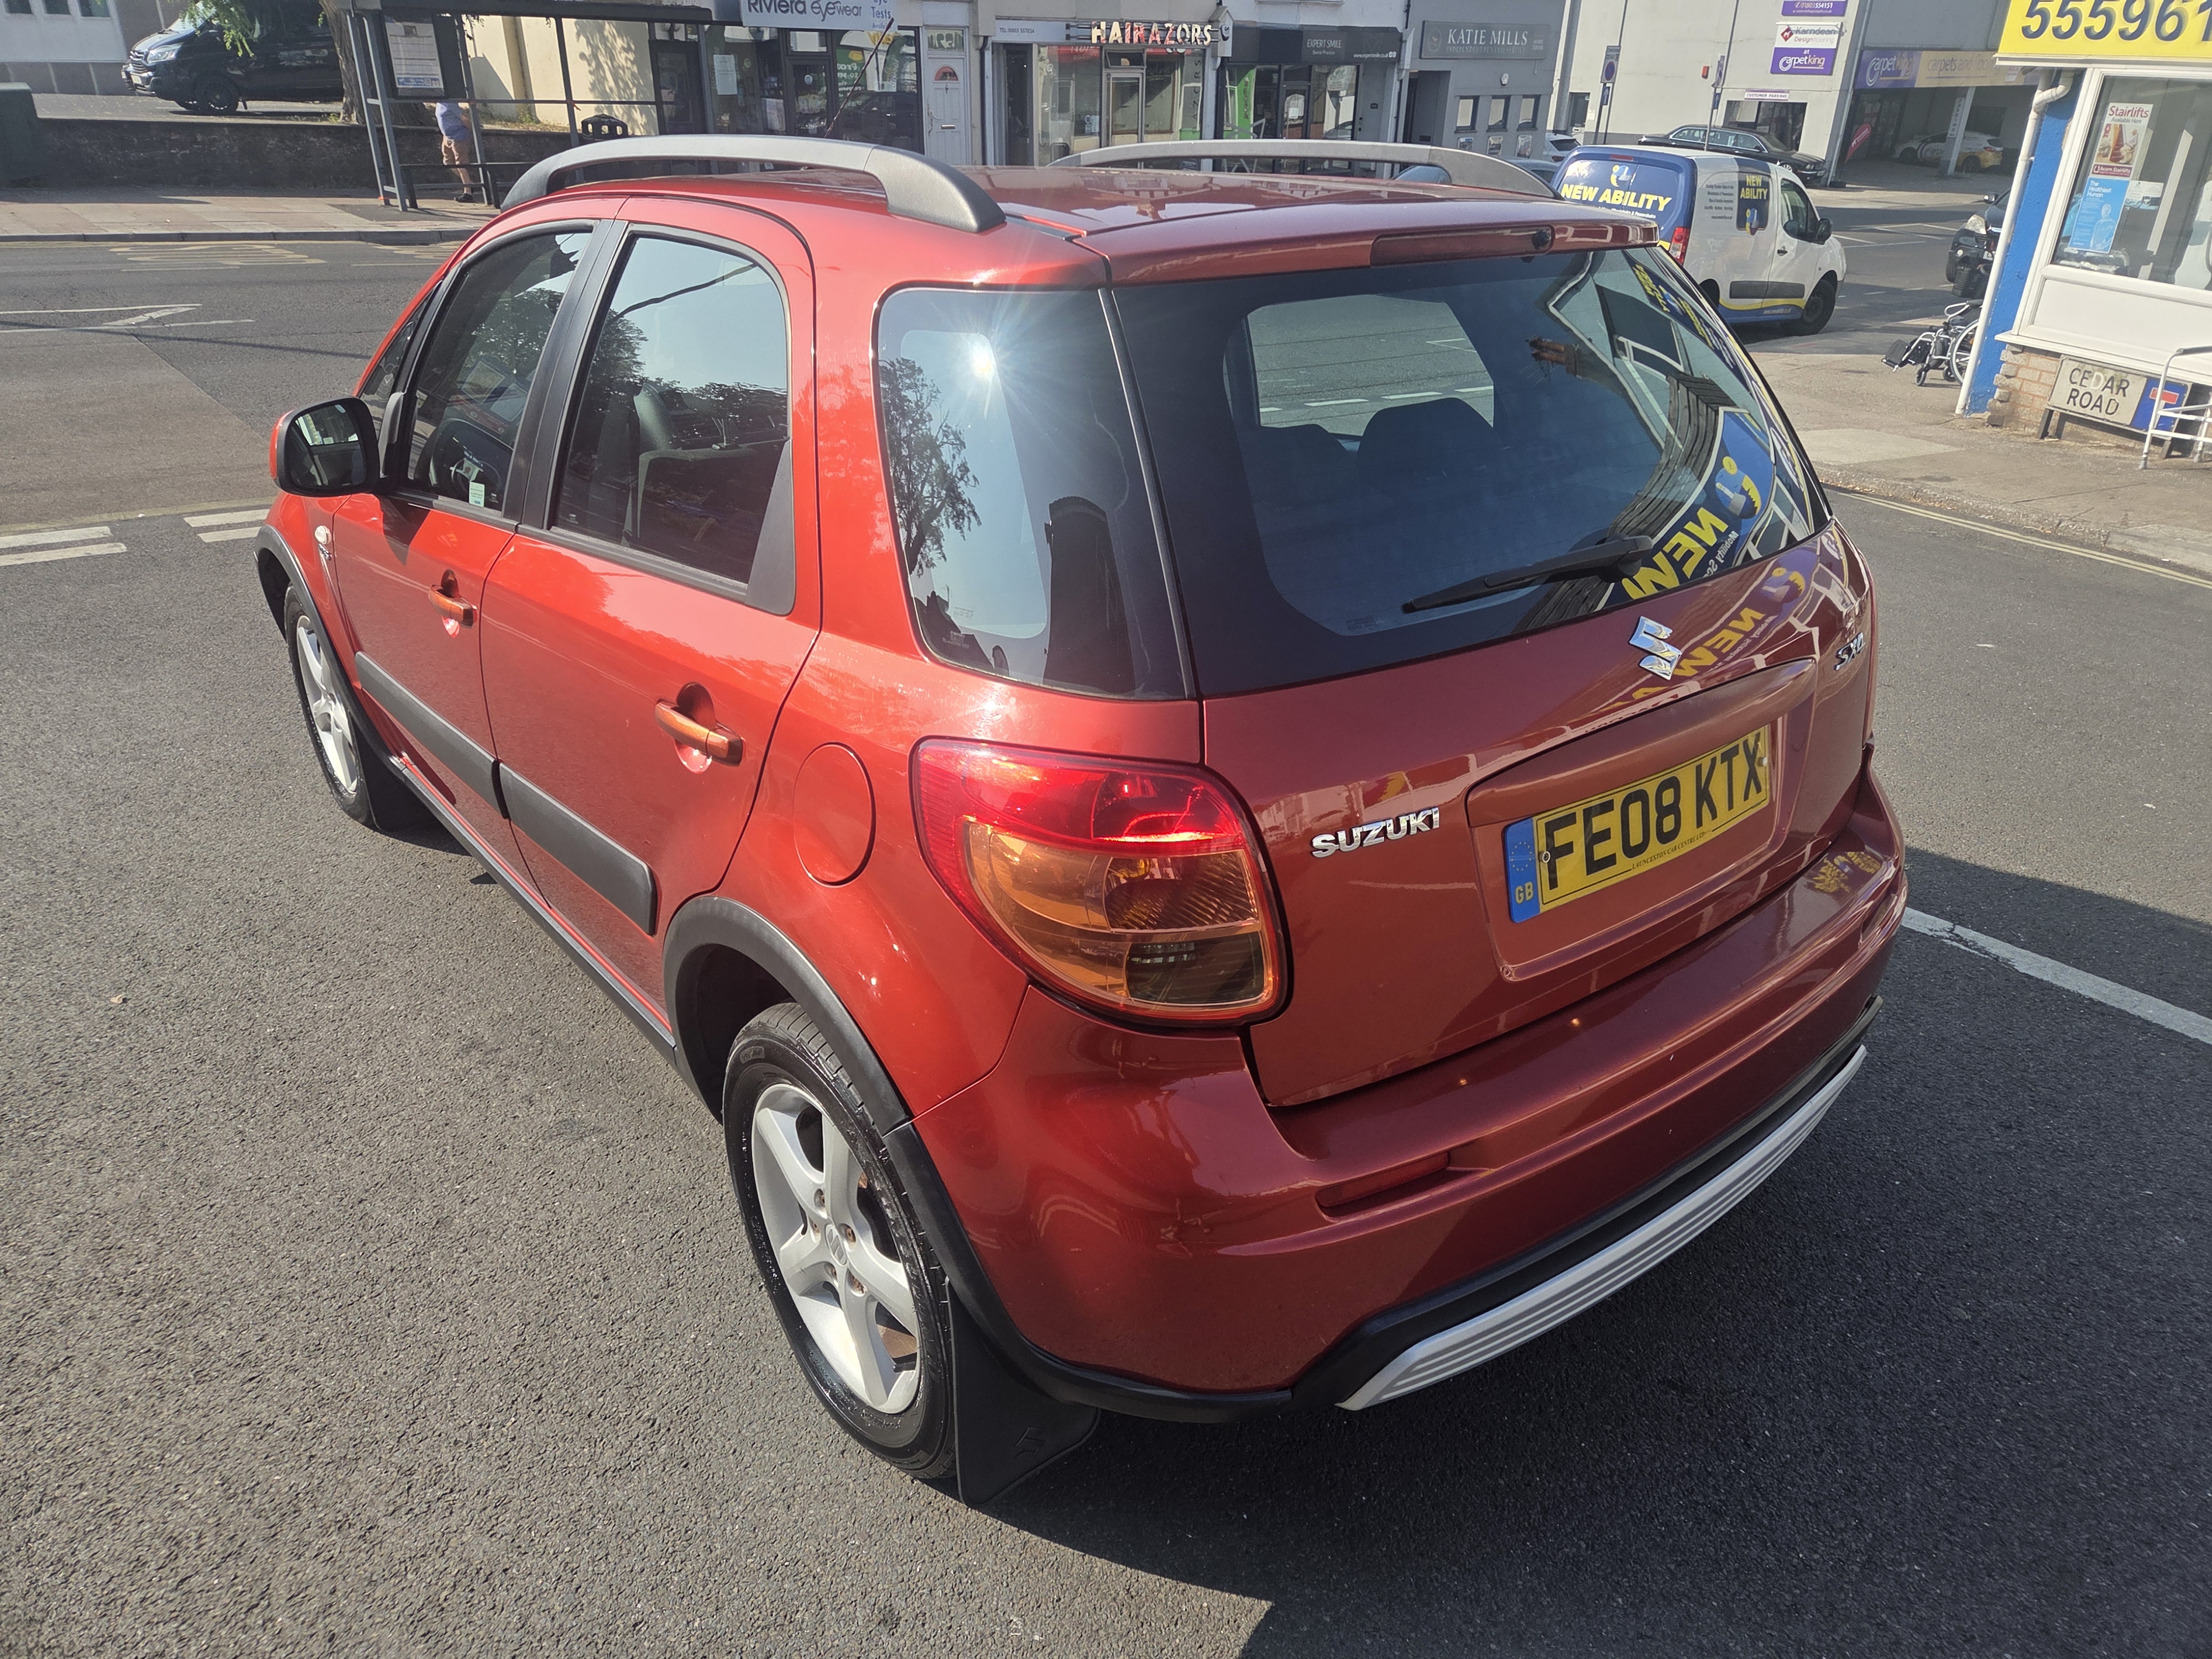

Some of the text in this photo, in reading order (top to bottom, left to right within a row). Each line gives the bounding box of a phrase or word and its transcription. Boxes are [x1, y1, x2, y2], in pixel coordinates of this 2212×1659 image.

[811, 1, 862, 22] eyewear
[872, 7, 891, 19] Tests
[1091, 21, 1212, 45] HAIRAZORS
[1448, 29, 1486, 45] KATIE
[1490, 30, 1528, 45] MILLS
[1796, 27, 1836, 35] Karndean
[1307, 39, 1342, 48] EXPERT SMILE
[2109, 106, 2150, 118] Stairlifts
[1746, 175, 1762, 187] NEW
[1561, 184, 1599, 201] NEW
[1598, 189, 1672, 211] ABILITY
[1740, 187, 1768, 200] ABILITY
[2069, 368, 2130, 397] CEDAR
[2067, 388, 2119, 415] ROAD
[1545, 731, 1762, 891] FE08 KTX
[1312, 807, 1440, 858] SUZUKI
[1631, 849, 1667, 870] LAUNCESTON
[1515, 881, 1534, 904] GB
